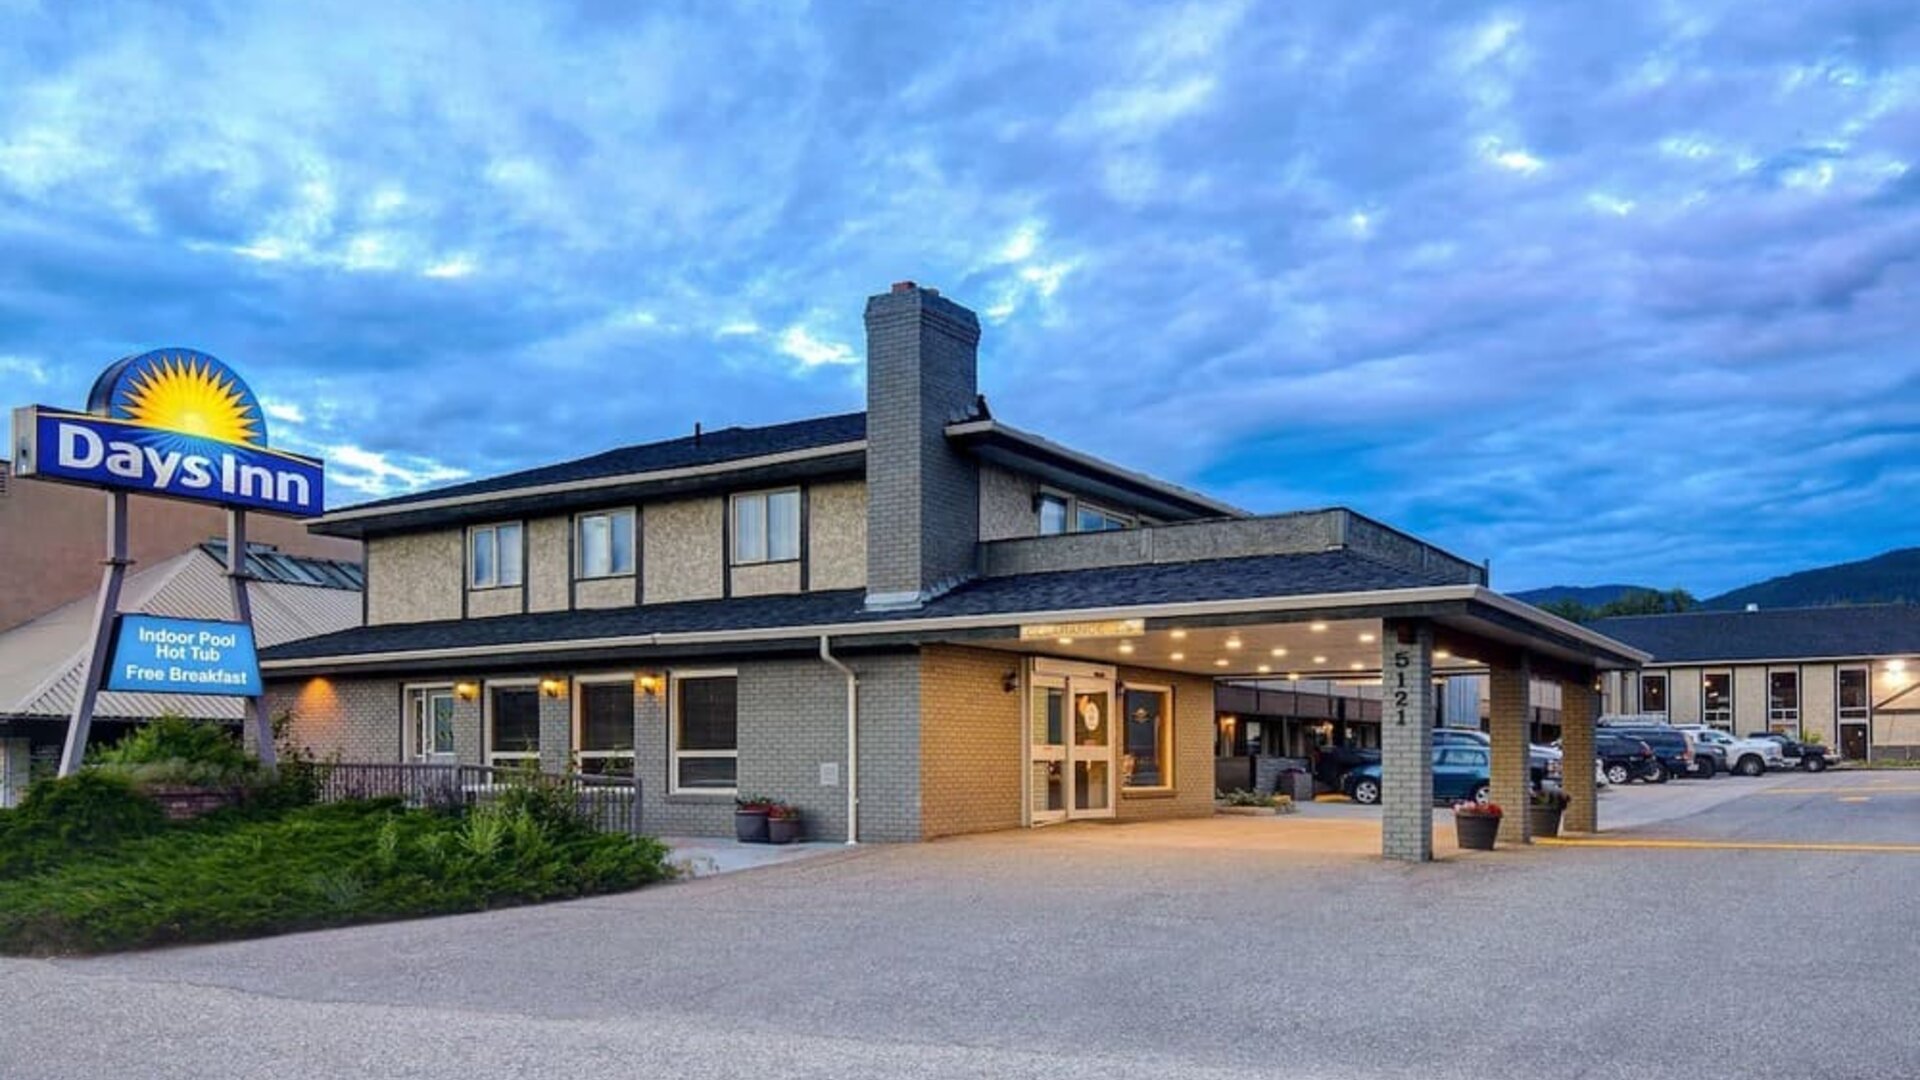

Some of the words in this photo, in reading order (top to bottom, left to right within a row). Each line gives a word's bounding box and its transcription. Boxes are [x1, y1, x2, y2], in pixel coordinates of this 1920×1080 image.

[59, 423, 212, 488] Days
[222, 453, 310, 506] Inn
[139, 627, 195, 644] Indoor
[199, 631, 235, 646] Pool
[156, 644, 186, 661] Hot
[190, 646, 220, 662] Tub
[126, 664, 164, 681] Free
[169, 667, 247, 684] Breakfast
[1395, 651, 1410, 726] 5121
